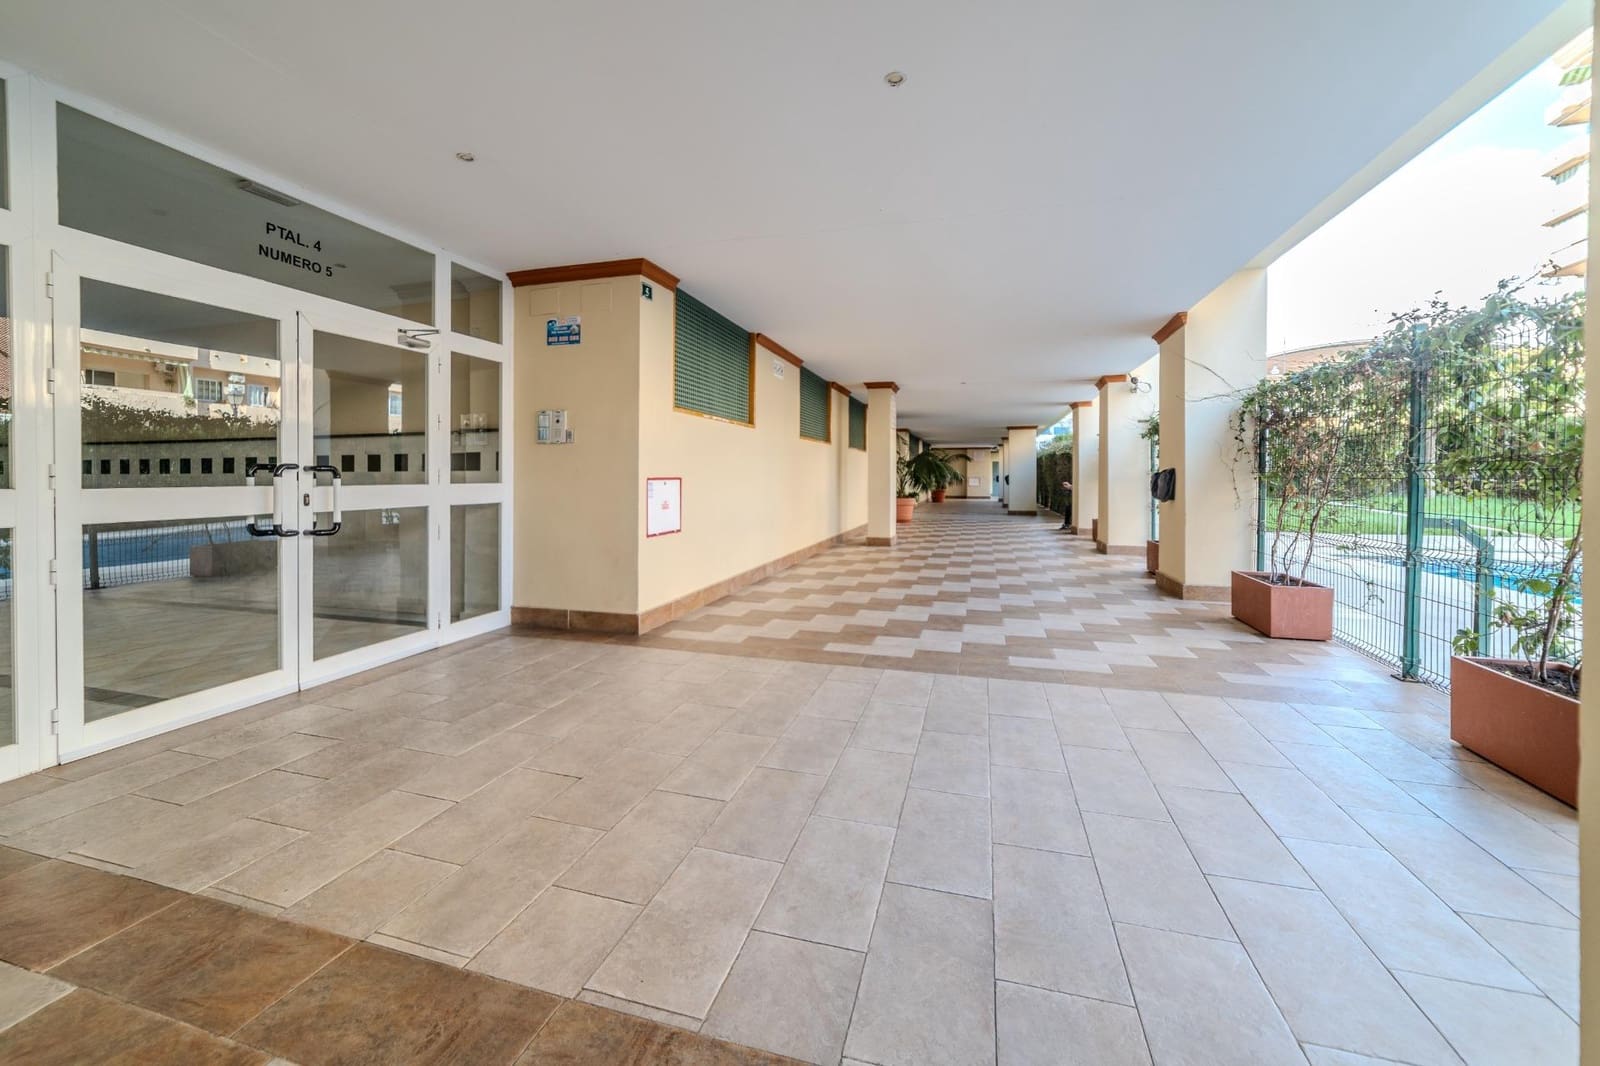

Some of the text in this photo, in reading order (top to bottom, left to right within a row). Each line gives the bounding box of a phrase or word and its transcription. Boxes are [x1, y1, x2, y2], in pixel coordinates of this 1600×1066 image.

[266, 222, 322, 252] PTAL. 4
[259, 243, 333, 277] NUMERO 5
